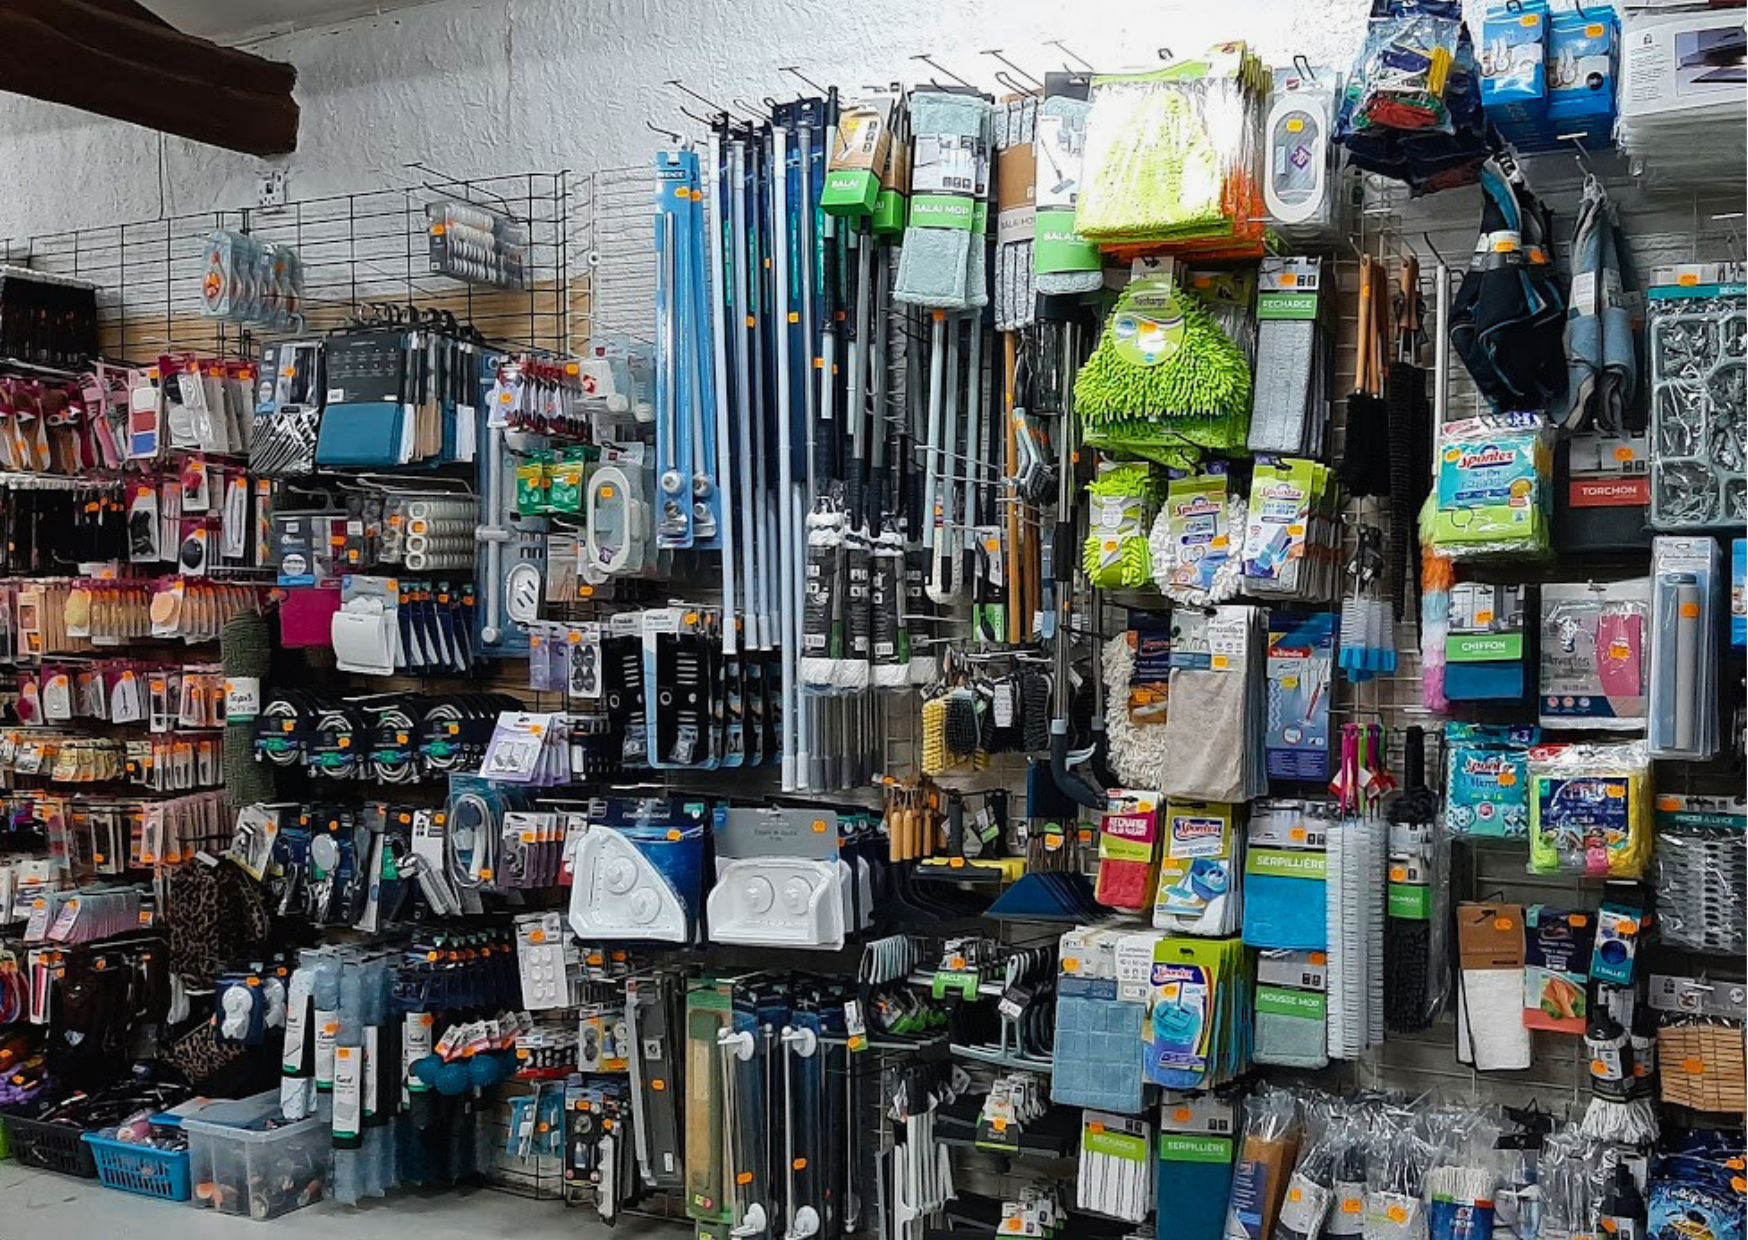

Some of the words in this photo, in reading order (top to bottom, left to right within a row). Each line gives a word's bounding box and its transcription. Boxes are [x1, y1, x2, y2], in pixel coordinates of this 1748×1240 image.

[831, 180, 860, 189] BALAI
[1262, 299, 1312, 309] RECHARGE
[1457, 450, 1514, 469] Spontex
[1581, 485, 1637, 496] TORCHON
[1461, 641, 1506, 652] CHIFFON
[1256, 855, 1325, 869] SERPILLIÈRE
